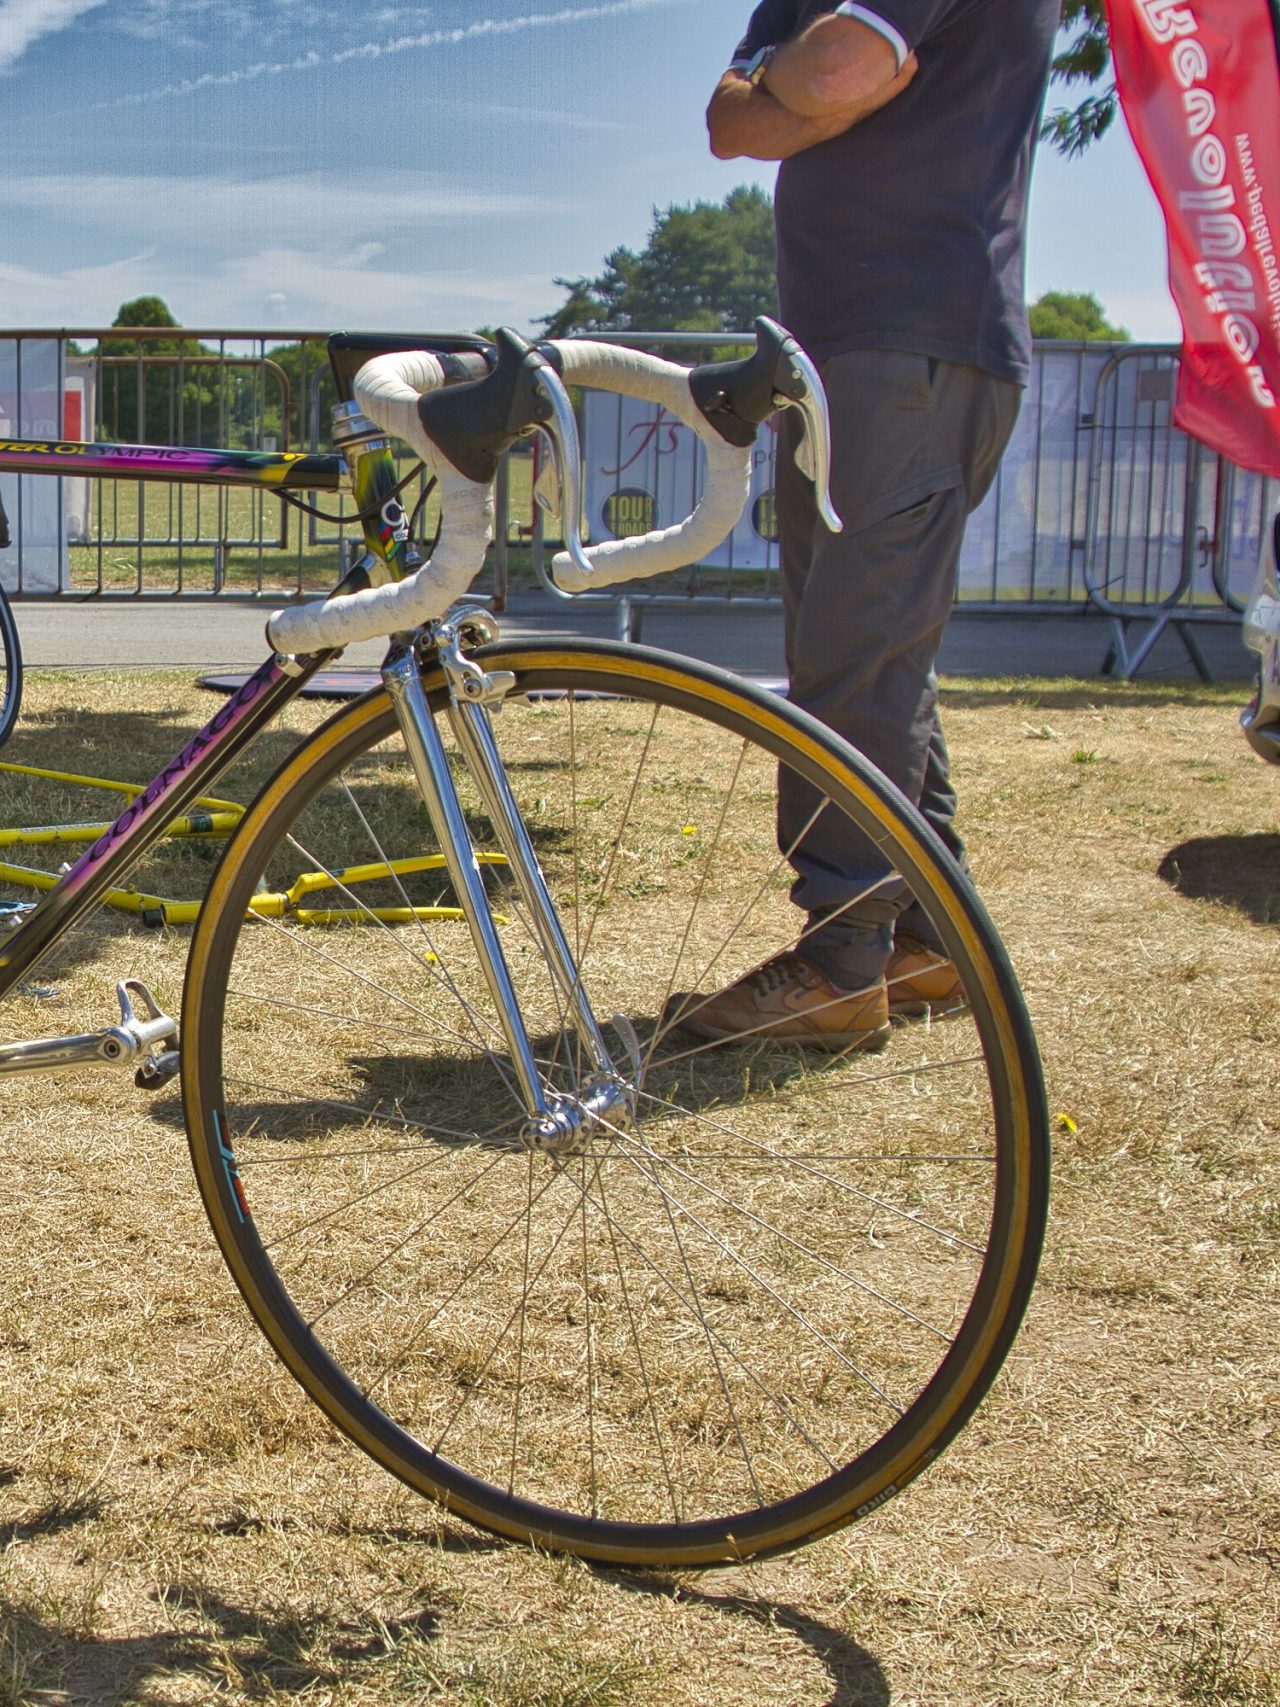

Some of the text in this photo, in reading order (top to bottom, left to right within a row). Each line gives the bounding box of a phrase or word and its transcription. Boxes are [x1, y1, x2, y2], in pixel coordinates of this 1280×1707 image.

[54, 444, 190, 461] OLYMPIC
[608, 495, 653, 521] TOUR
[88, 675, 263, 863] COLNAGO
